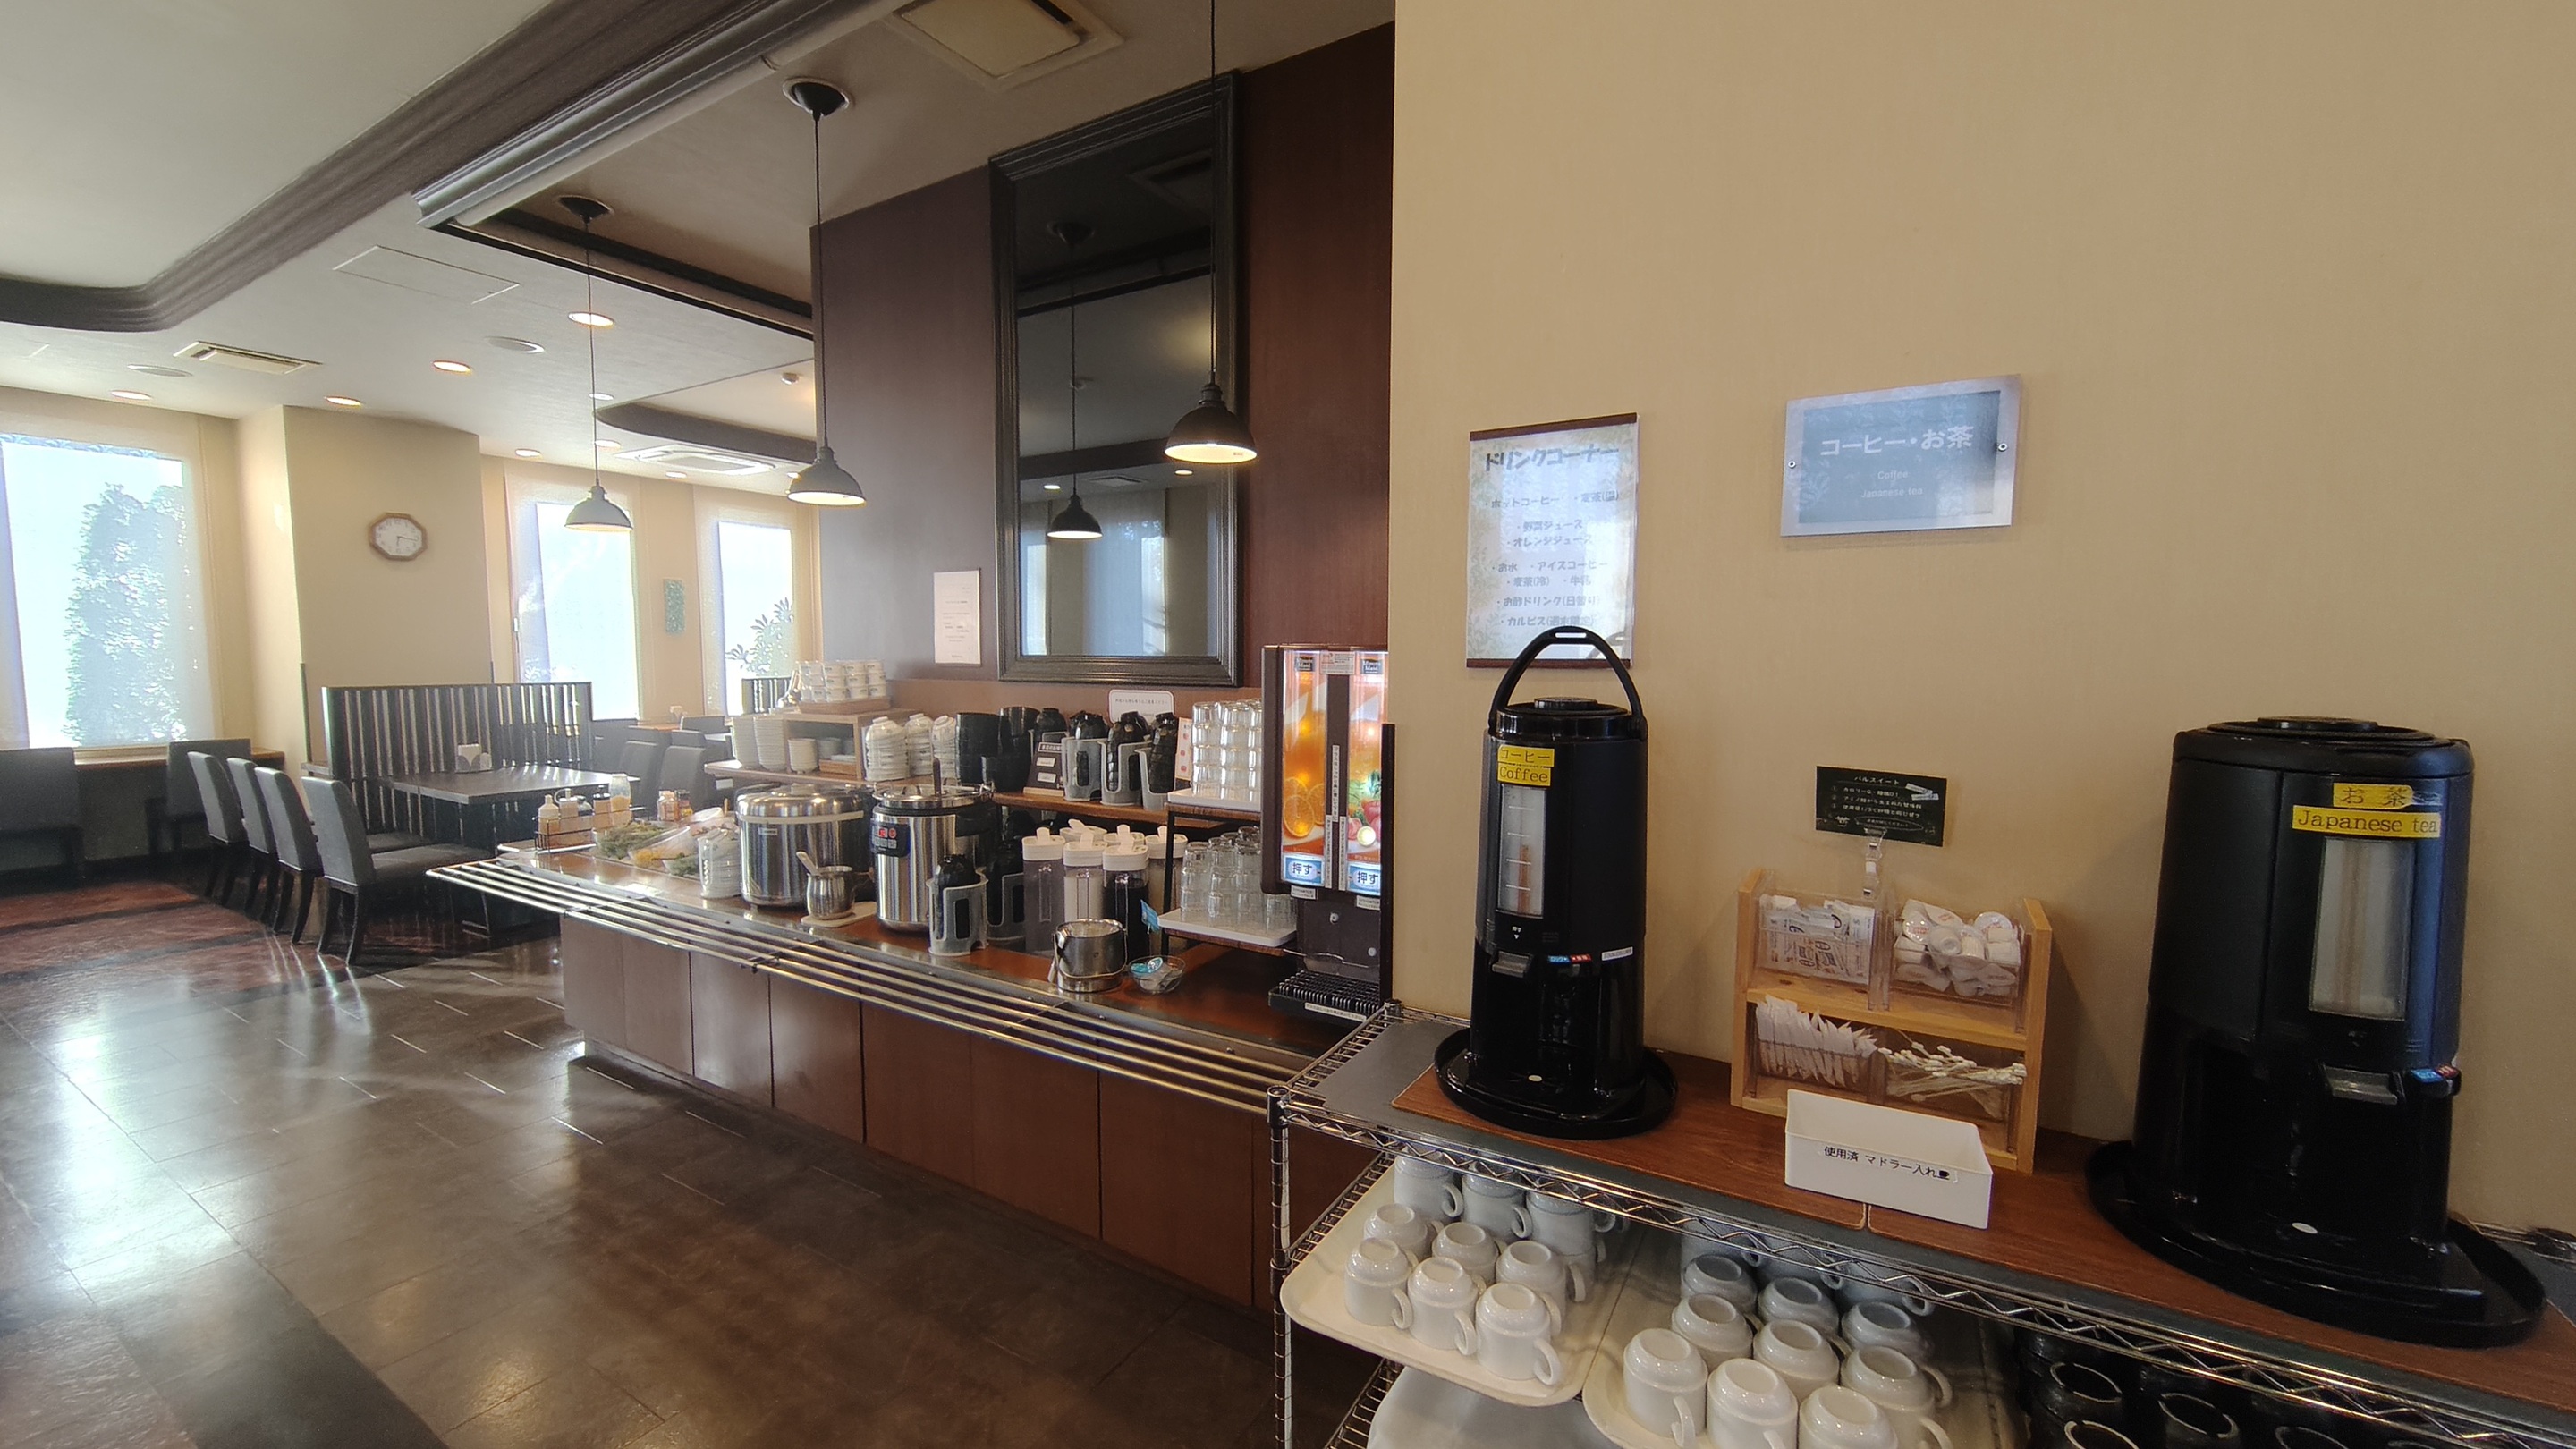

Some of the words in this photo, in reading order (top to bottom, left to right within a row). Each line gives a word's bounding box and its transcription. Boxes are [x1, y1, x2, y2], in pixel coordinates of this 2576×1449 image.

[1820, 425, 1974, 456] コーヒー・お茶
[1485, 444, 1620, 472] ドリンクコーナー
[1877, 470, 1909, 481] Coffee
[1501, 750, 1550, 763] コーヒー
[1499, 766, 1548, 783] Coffee
[2298, 809, 2403, 833] Japanese
[2412, 819, 2437, 834] tea
[1292, 861, 1313, 875] 押す
[1357, 870, 1378, 885] 押す
[1824, 1146, 1859, 1162] 使用済
[1865, 1154, 1936, 1178] マドラー入れ
